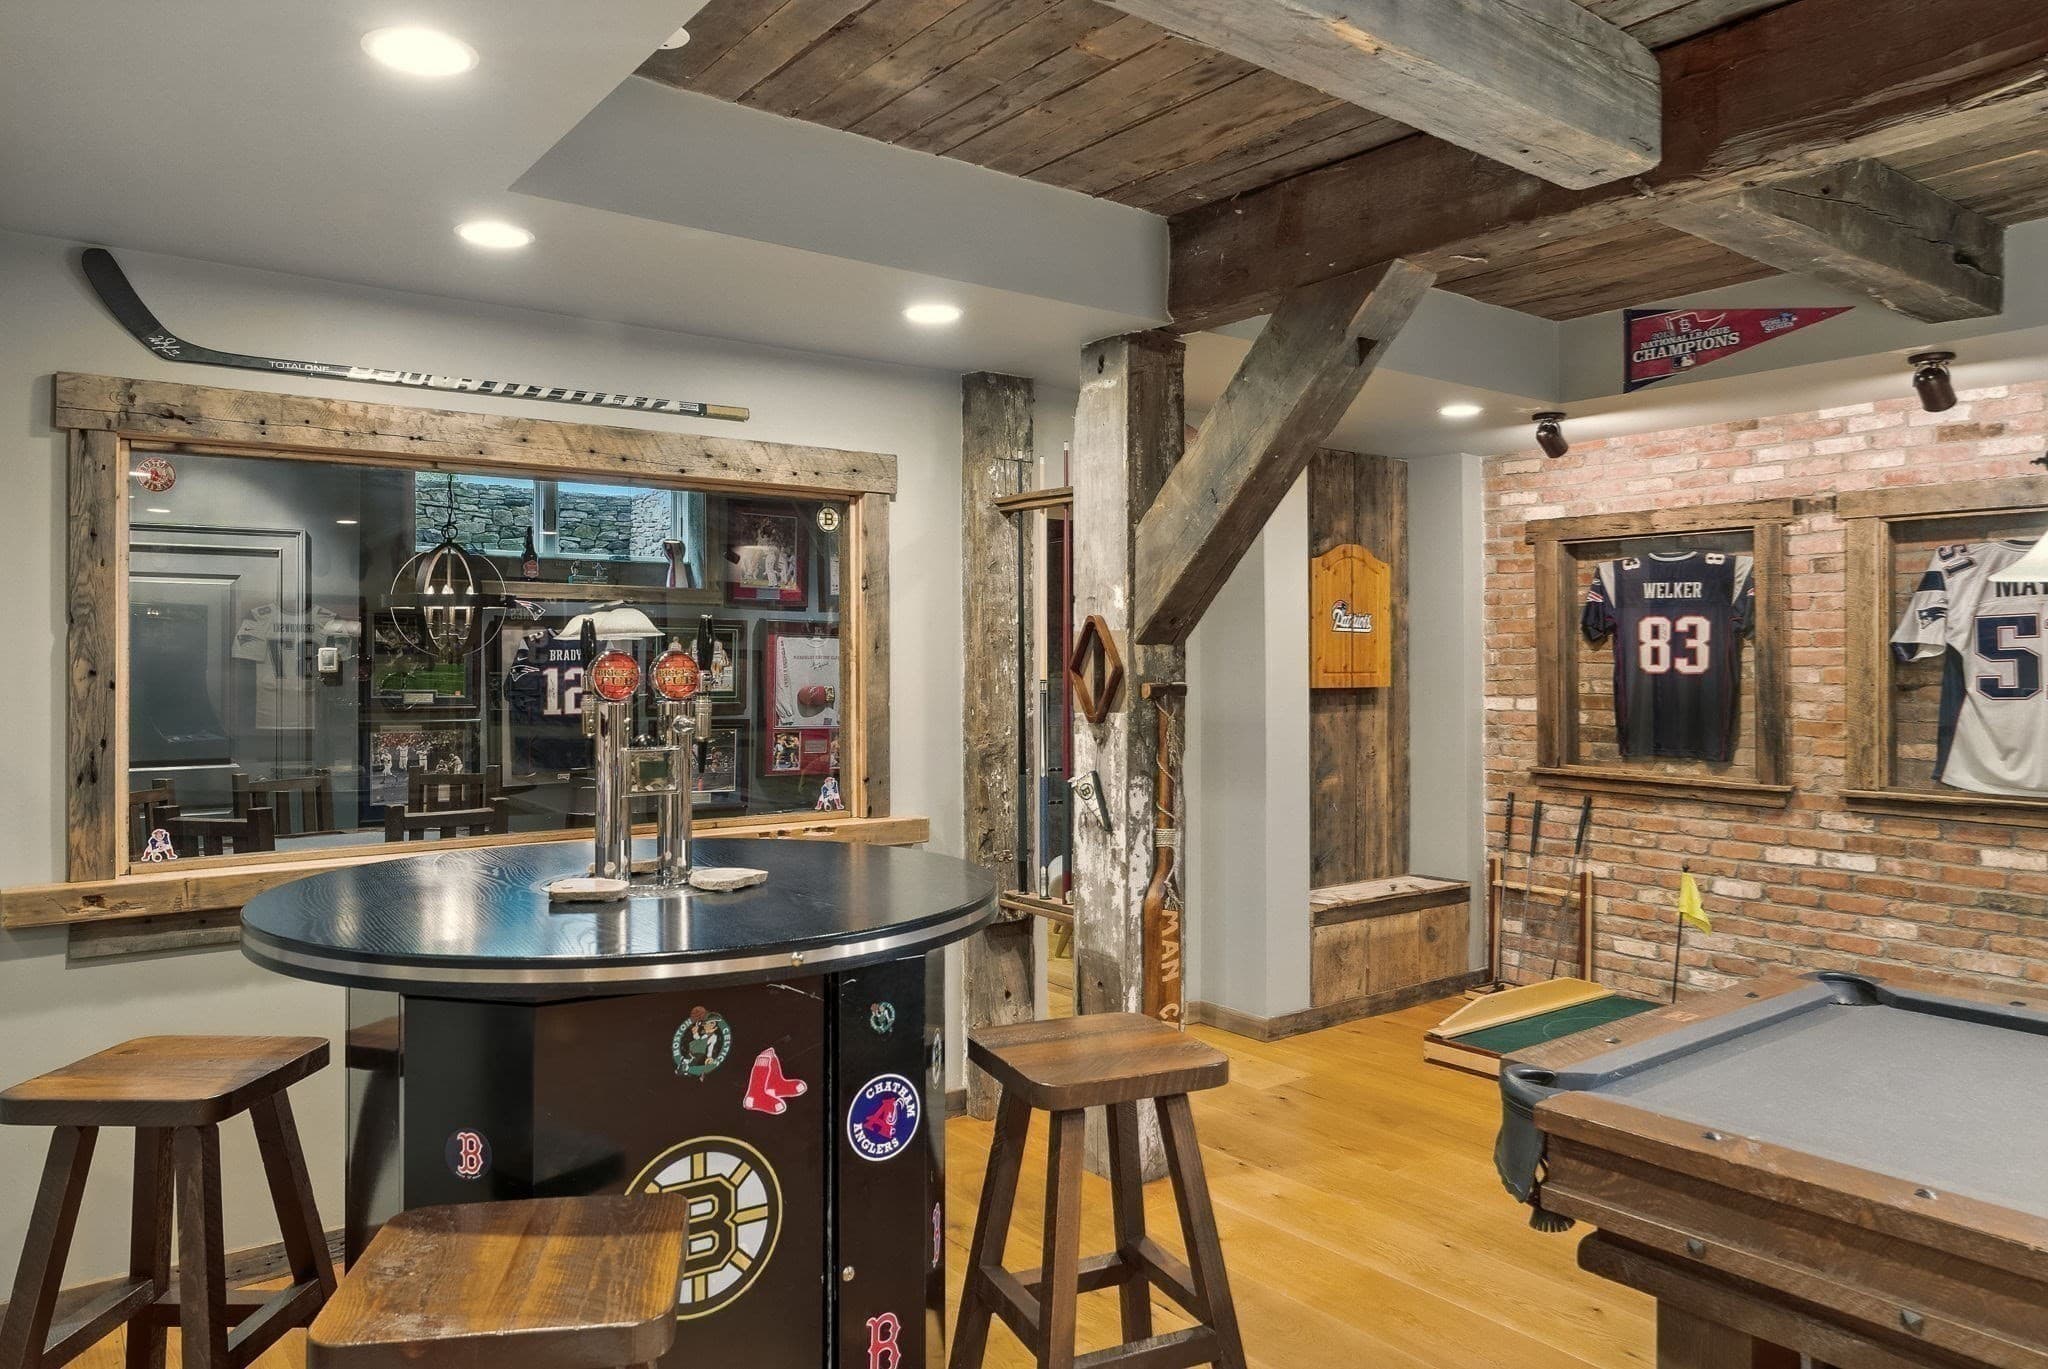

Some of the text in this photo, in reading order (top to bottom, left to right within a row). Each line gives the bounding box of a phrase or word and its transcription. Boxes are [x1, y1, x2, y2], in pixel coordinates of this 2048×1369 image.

[1632, 331, 1741, 363] CHAMPIONS
[1640, 335, 1688, 350] NATIONAL
[1688, 325, 1731, 341] LEAGUE
[823, 512, 835, 527] B
[1643, 581, 1702, 599] WELKER
[549, 649, 582, 661] BRADY
[1638, 614, 1711, 675] 83
[542, 667, 586, 715] 12
[1161, 909, 1179, 982] MAN
[865, 1081, 916, 1118] CHATHAM
[456, 1131, 484, 1175] B
[853, 1123, 900, 1155] ANGLERS
[865, 1312, 902, 1369] B
